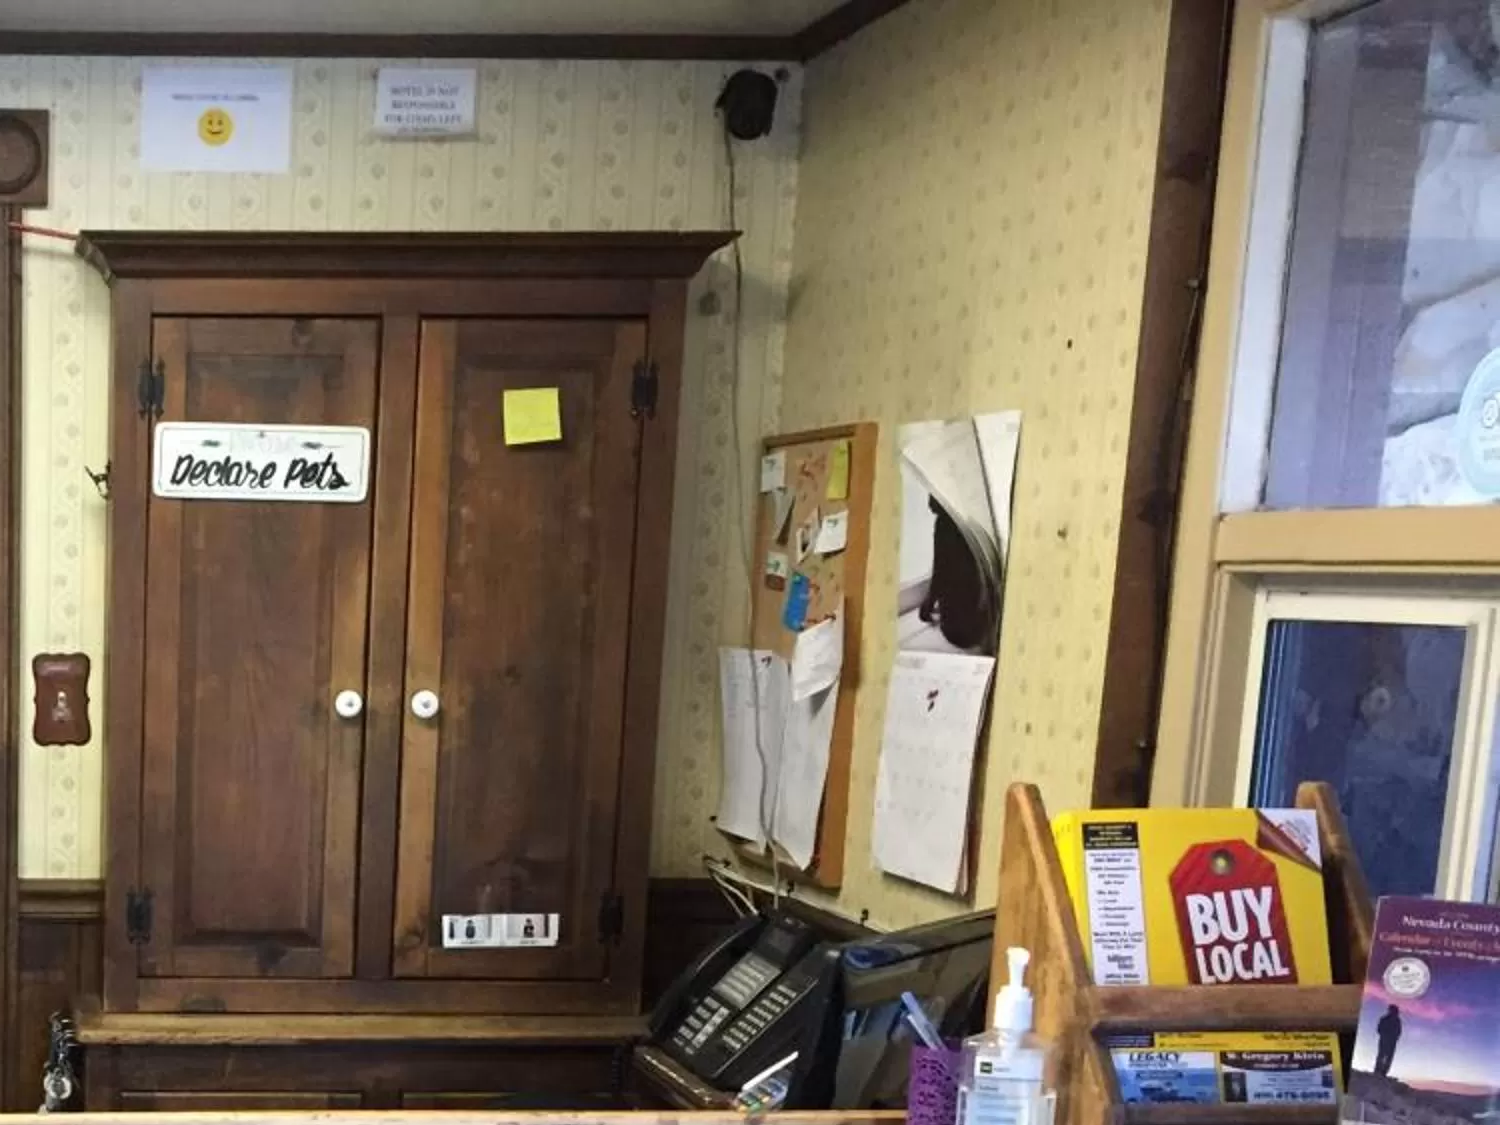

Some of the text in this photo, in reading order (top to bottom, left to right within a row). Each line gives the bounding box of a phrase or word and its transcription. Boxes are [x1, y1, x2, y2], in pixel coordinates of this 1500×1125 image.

[170, 452, 350, 490] Declare Pets
[1186, 886, 1273, 945] BUY
[1402, 915, 1451, 930] Nevada
[1452, 919, 1500, 937] County
[1196, 939, 1290, 985] LOCAL
[1129, 1051, 1180, 1062] LEGACY
[1241, 1051, 1289, 1063] Gregory
